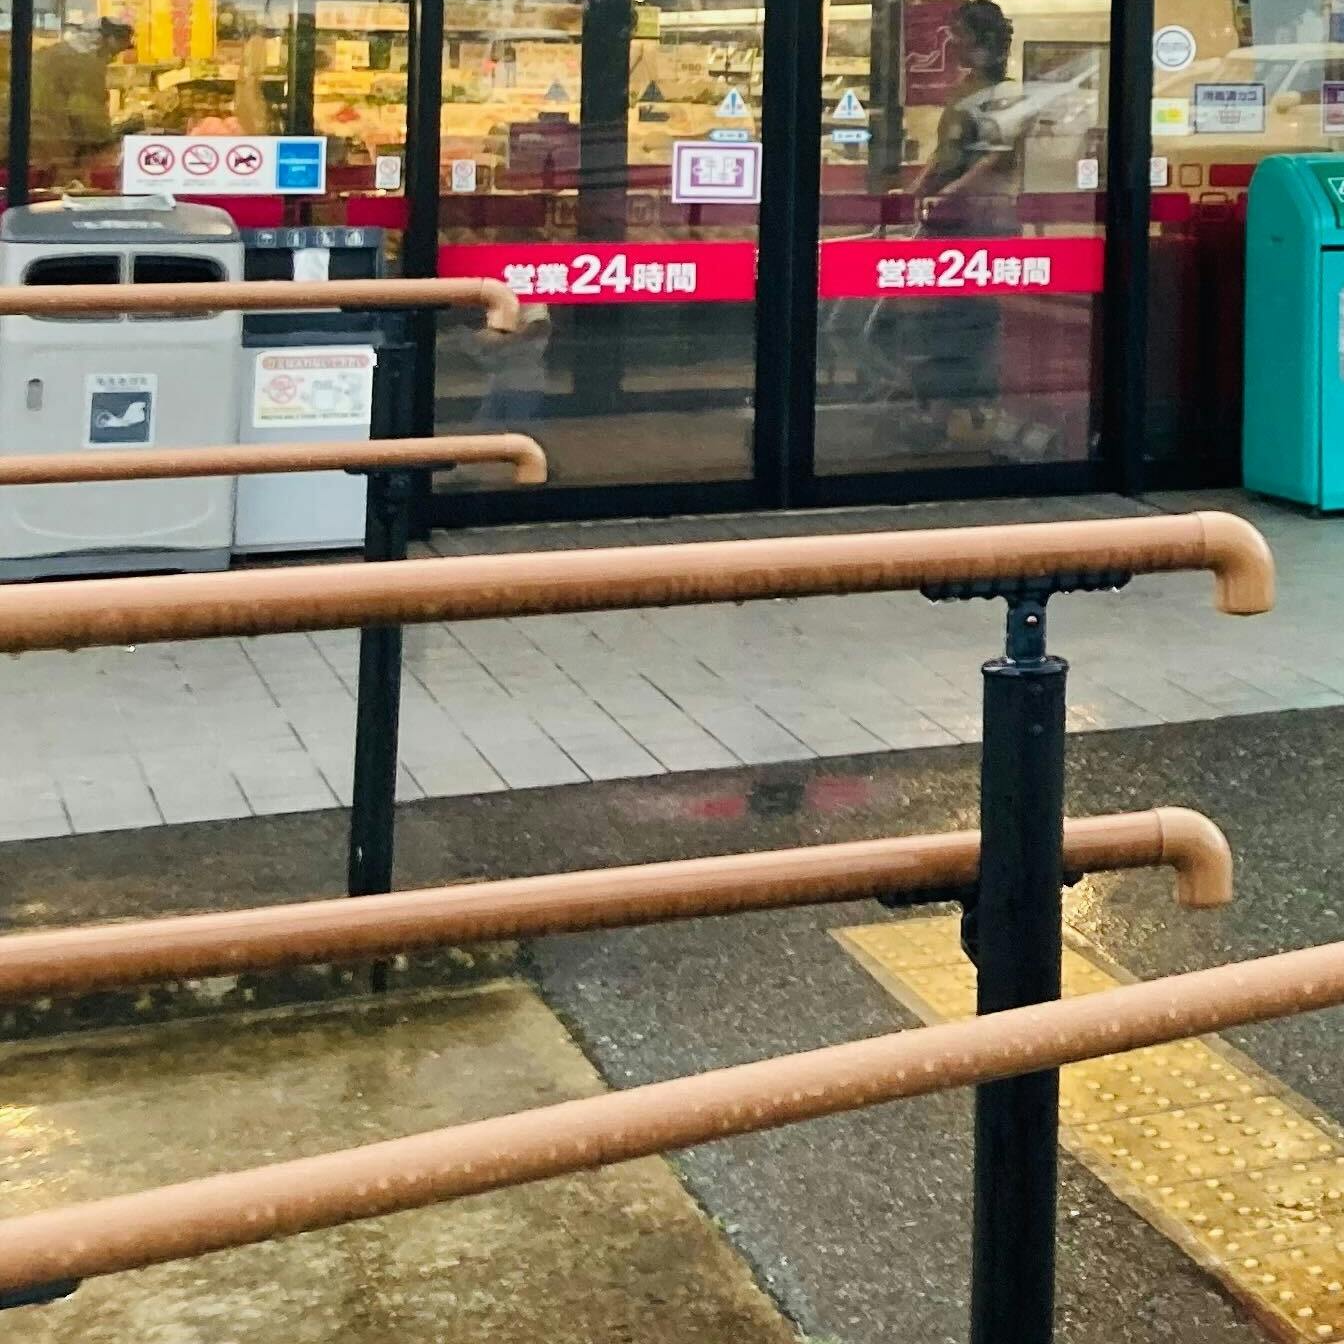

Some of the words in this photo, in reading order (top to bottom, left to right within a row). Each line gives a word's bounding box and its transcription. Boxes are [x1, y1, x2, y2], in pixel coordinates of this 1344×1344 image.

[503, 254, 698, 294] 営業24時間
[876, 249, 1051, 288] 営業24時間
